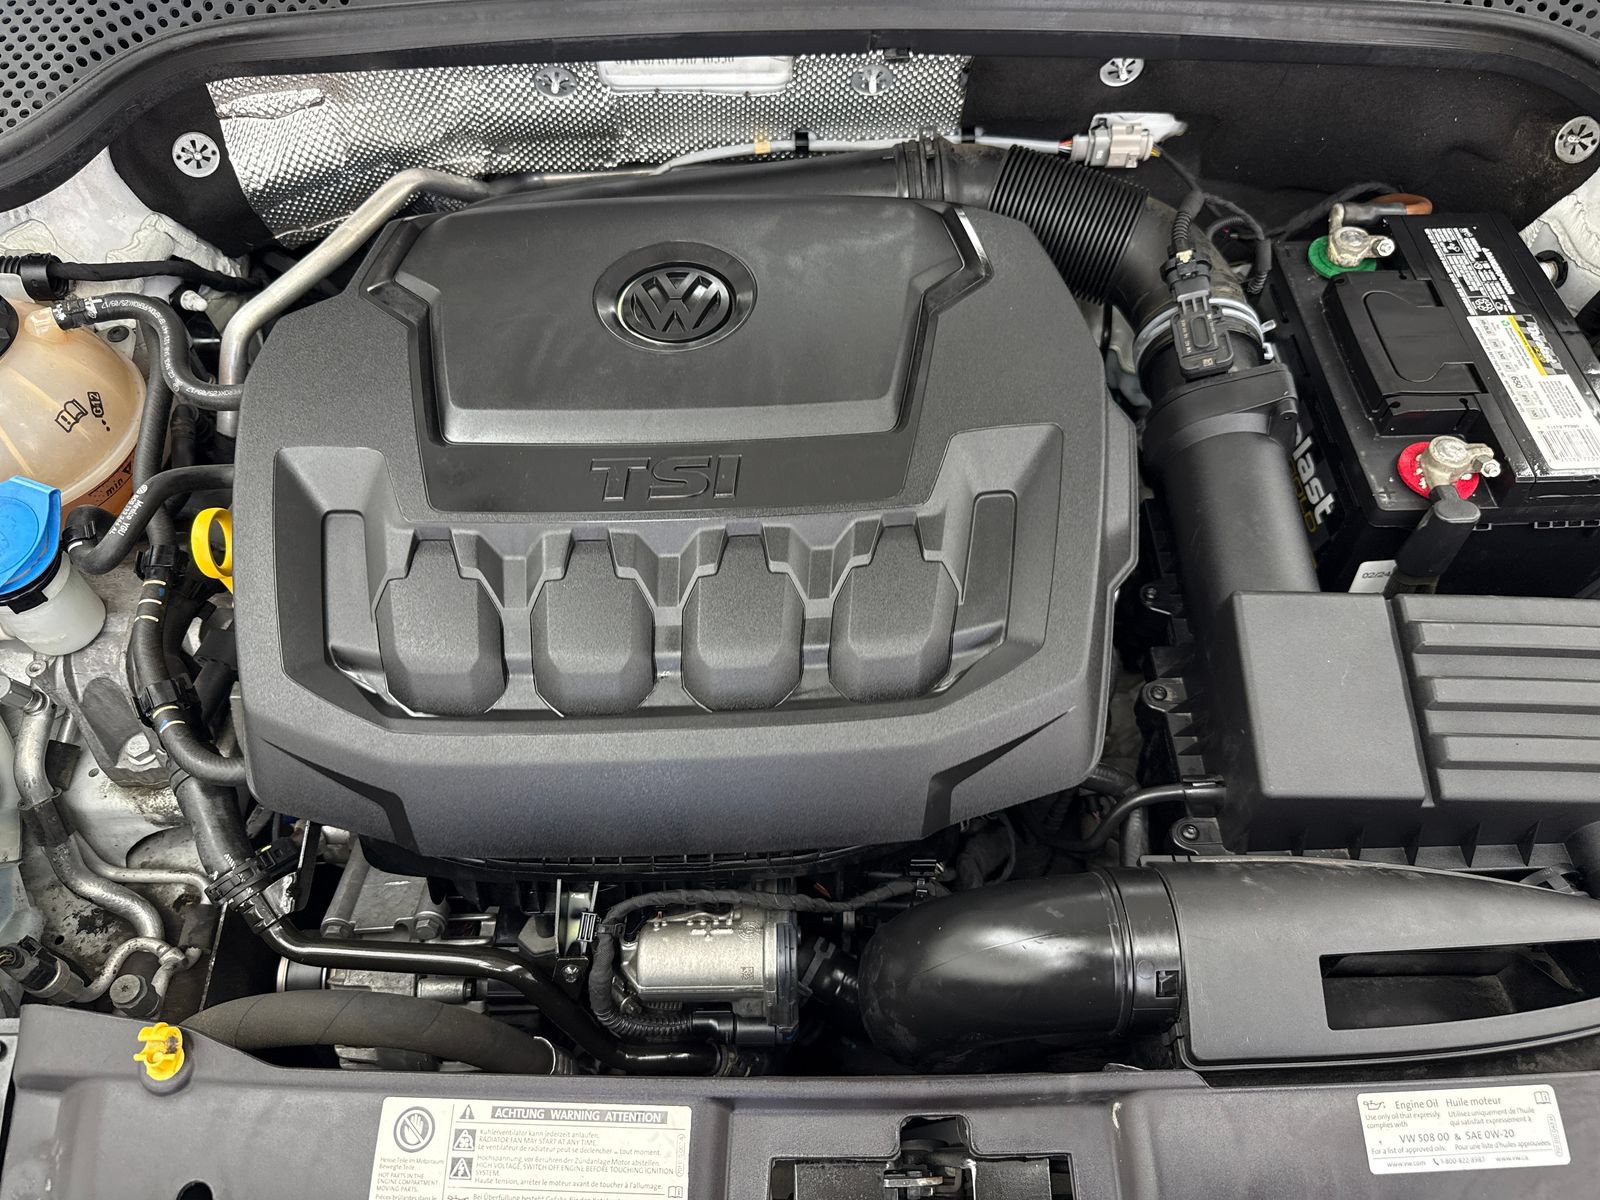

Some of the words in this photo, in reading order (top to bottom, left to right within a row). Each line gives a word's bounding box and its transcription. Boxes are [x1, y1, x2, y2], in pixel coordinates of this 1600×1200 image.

[1510, 375, 1524, 389] 650
[89, 392, 103, 416] G12
[590, 454, 743, 502] TSI
[105, 478, 124, 497] min
[127, 500, 144, 521] Mexico
[117, 520, 131, 537] YGU
[1394, 1100, 1424, 1112] Engine
[1426, 1098, 1439, 1108] Oil
[1445, 1097, 1469, 1108] Huile
[1470, 1097, 1501, 1106] moteur
[494, 1106, 545, 1120] ACHTUNG
[550, 1108, 600, 1121] WARNING
[604, 1110, 662, 1123] ATTENTION
[1378, 1113, 1390, 1122] only
[1413, 1110, 1440, 1120] expressly
[1448, 1110, 1470, 1118] Utilisez
[1471, 1109, 1507, 1117] uniquement
[1367, 1122, 1393, 1130] complies
[1461, 1118, 1484, 1126] satisfait
[1399, 1134, 1416, 1143] VW
[1418, 1133, 1435, 1142] 508
[1437, 1132, 1450, 1141] 00
[1465, 1130, 1482, 1140] SAE
[1484, 1129, 1515, 1139] 0W-20
[1405, 1145, 1433, 1154] approved
[574, 1157, 610, 1166] Zündanlage
